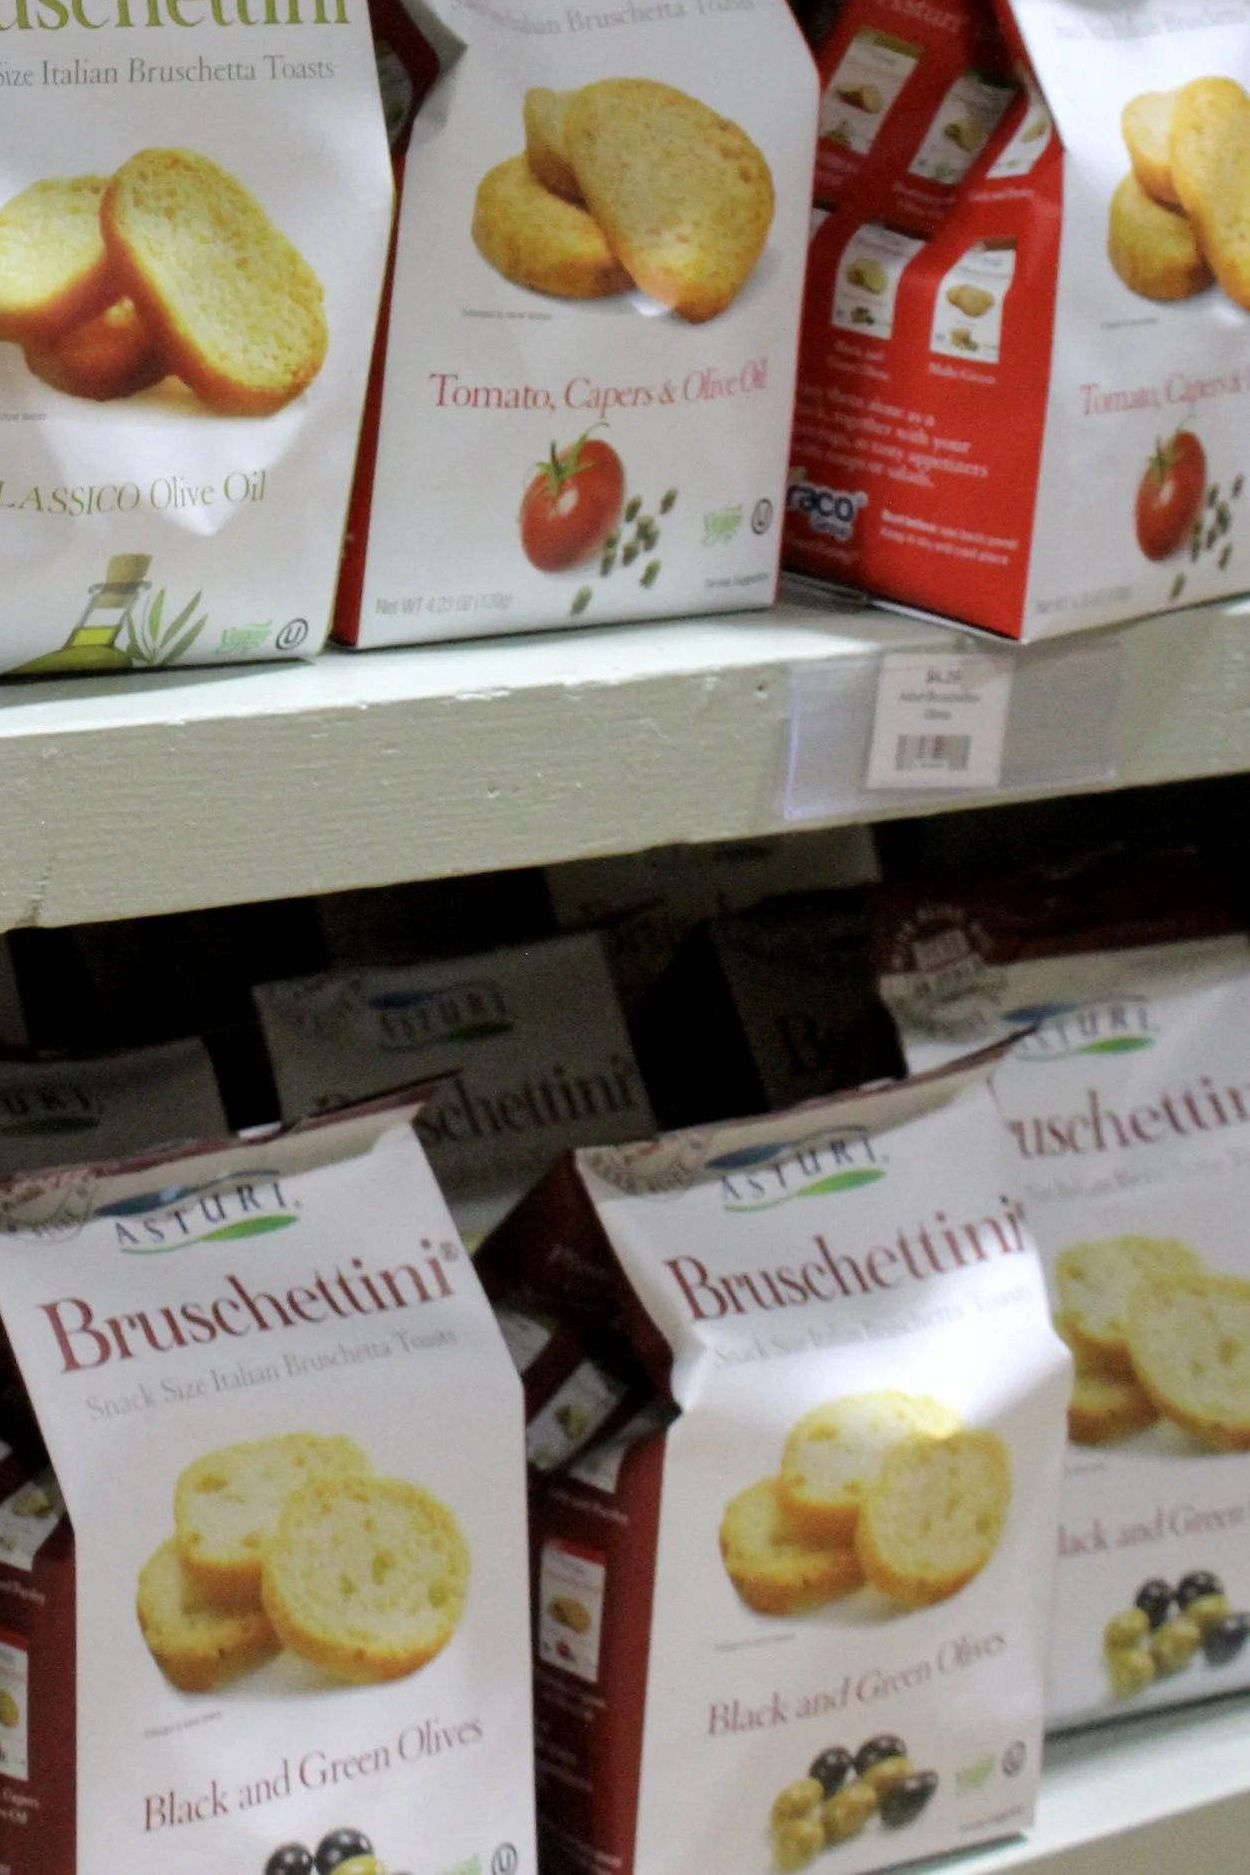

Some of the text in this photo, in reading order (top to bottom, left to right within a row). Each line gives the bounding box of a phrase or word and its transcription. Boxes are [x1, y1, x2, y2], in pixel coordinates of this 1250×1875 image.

[42, 59, 118, 86] Italian
[128, 55, 258, 85] Bruschetta
[263, 55, 335, 82] Toasts
[429, 358, 768, 418] Tomato, Capers & Olive Oil
[150, 476, 214, 509] Olive
[223, 470, 266, 504] Oil
[116, 1180, 290, 1247] ASTURI
[86, 1325, 459, 1423] Snack Size Italian Bruschetta Toasts
[706, 1630, 1007, 1738] Black and Green Olives
[143, 1715, 484, 1834] Black and Green Olives
